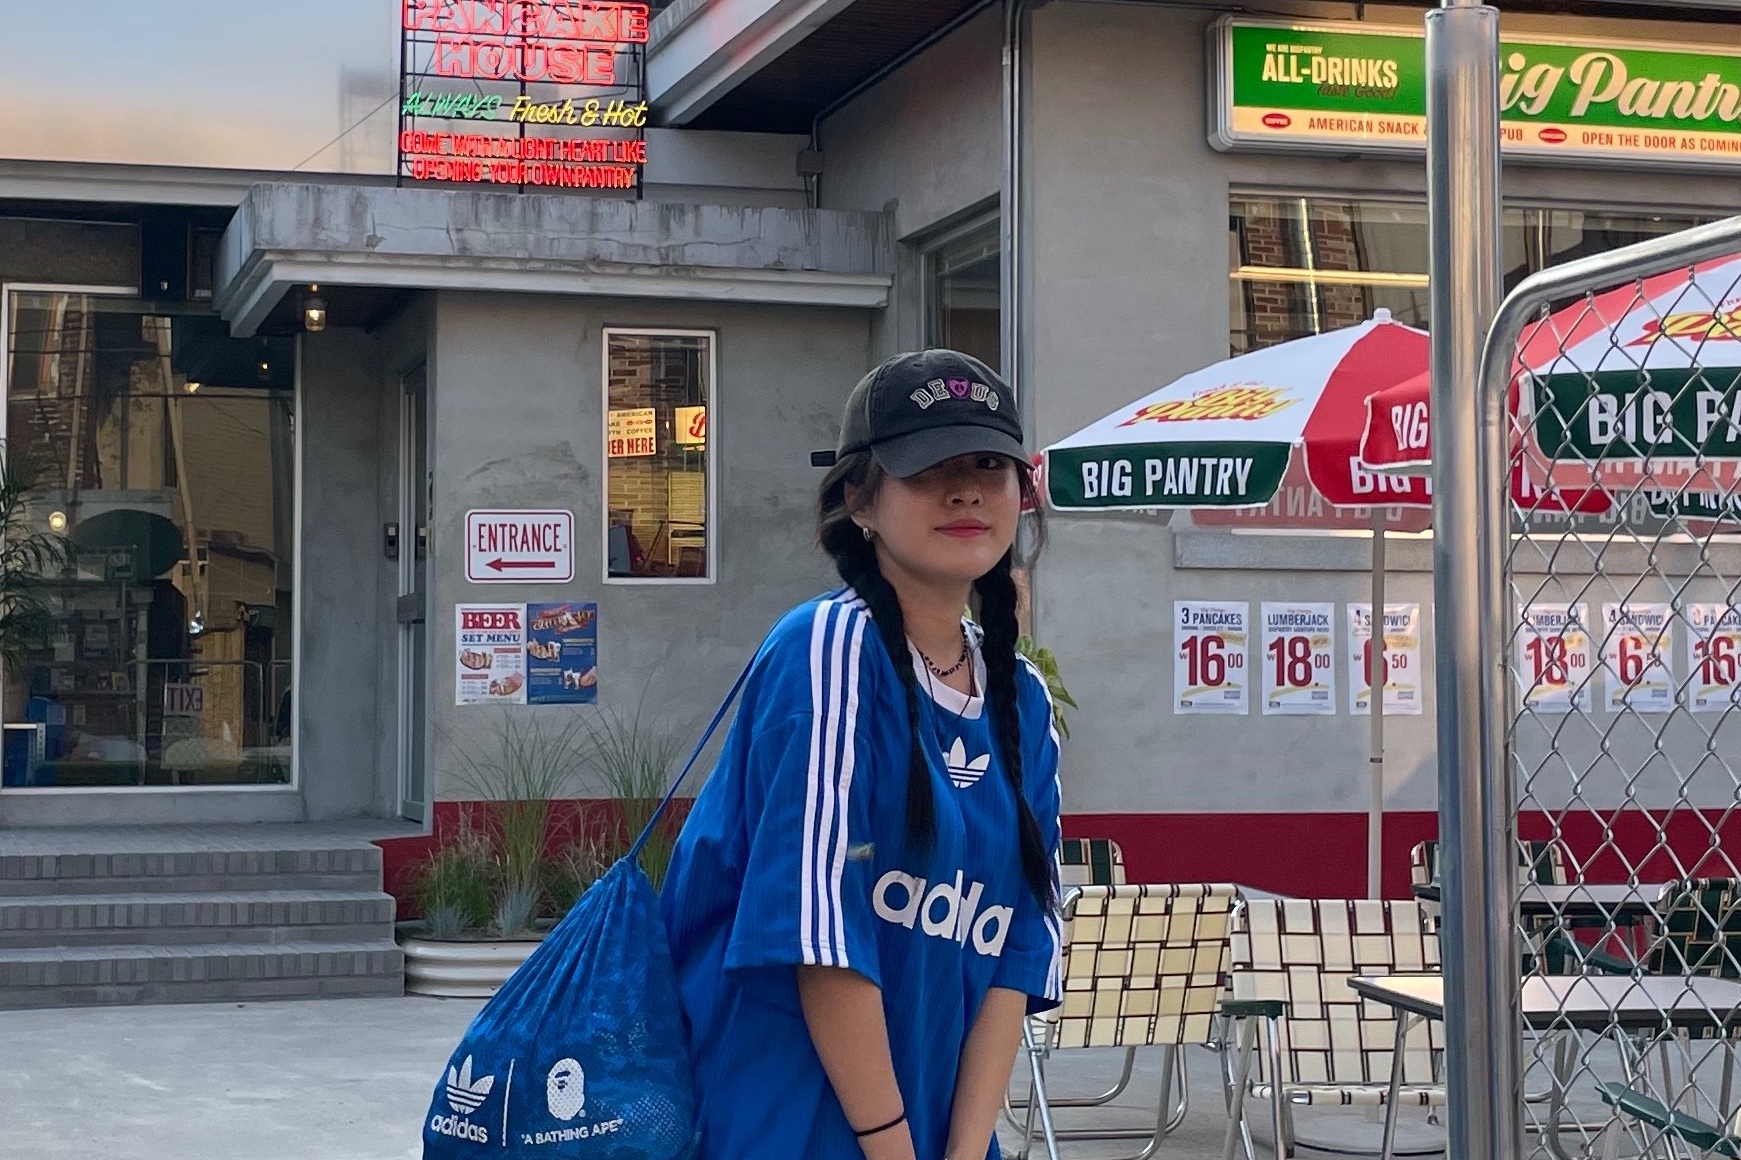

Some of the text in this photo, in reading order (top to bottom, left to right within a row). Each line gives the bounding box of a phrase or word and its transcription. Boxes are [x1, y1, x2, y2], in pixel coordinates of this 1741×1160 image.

[402, 0, 650, 43] PANCAKE
[436, 36, 616, 85] HOUSE
[1262, 53, 1398, 88] ALL-DRINKS
[1500, 52, 1741, 121] ig Pantr
[509, 96, 577, 125] Fresh
[580, 99, 600, 127] &
[602, 99, 648, 127] Hot
[1308, 117, 1373, 133] AMERICAN
[1378, 122, 1419, 135] SNACK
[401, 131, 447, 154] COME
[450, 132, 493, 157] WITH
[511, 137, 557, 160] LIGHT
[560, 140, 610, 162] HEART
[613, 140, 648, 163] LIKE
[1582, 132, 1613, 146] OPEN
[1618, 134, 1640, 147] THE
[1644, 136, 1676, 149] DOOR
[1680, 138, 1696, 150] AS
[1700, 139, 1741, 153] COMIN
[412, 157, 636, 189] OPENING YOUR OWN PANTRY
[1391, 401, 1429, 451] BIG
[1588, 391, 1674, 445] BIG
[627, 437, 655, 454] HERE
[1082, 457, 1253, 498] BIG PANTRY
[478, 523, 562, 552] ENTRANCE
[461, 611, 521, 630] BEER
[1181, 607, 1243, 625] 3 PANCAKES
[1267, 614, 1329, 626] LUMBERJACK
[1364, 614, 1413, 627] SDWIC
[461, 634, 520, 643] SET MENU
[1181, 635, 1225, 687] 16
[1227, 653, 1243, 669] 00
[1269, 636, 1313, 687] 18
[1314, 653, 1330, 669] 00
[1392, 654, 1407, 669] 50
[1571, 653, 1586, 668] 00
[430, 1113, 489, 1145] adidas
[536, 1125, 589, 1145] BATHING
